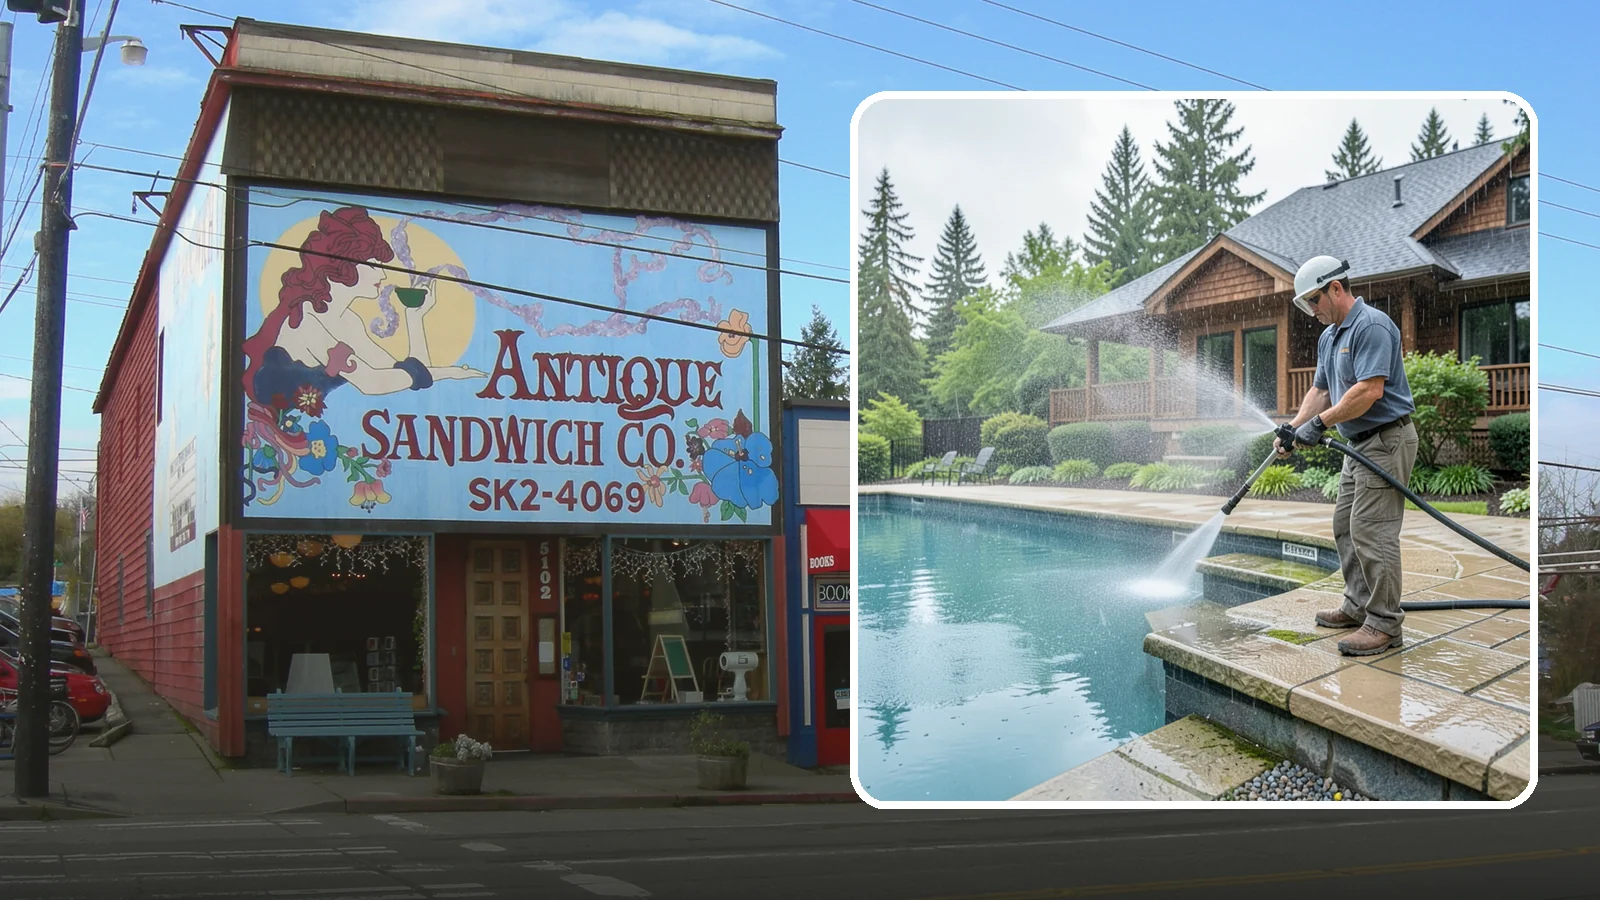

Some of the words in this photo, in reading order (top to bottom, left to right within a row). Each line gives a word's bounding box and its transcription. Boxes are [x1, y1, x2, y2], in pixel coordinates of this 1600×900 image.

[361, 408, 604, 467] SANDWICH
[616, 422, 685, 468] CO.
[468, 477, 645, 512] SK2-4069
[540, 542, 551, 599] 5102
[810, 555, 834, 568] BOOKS
